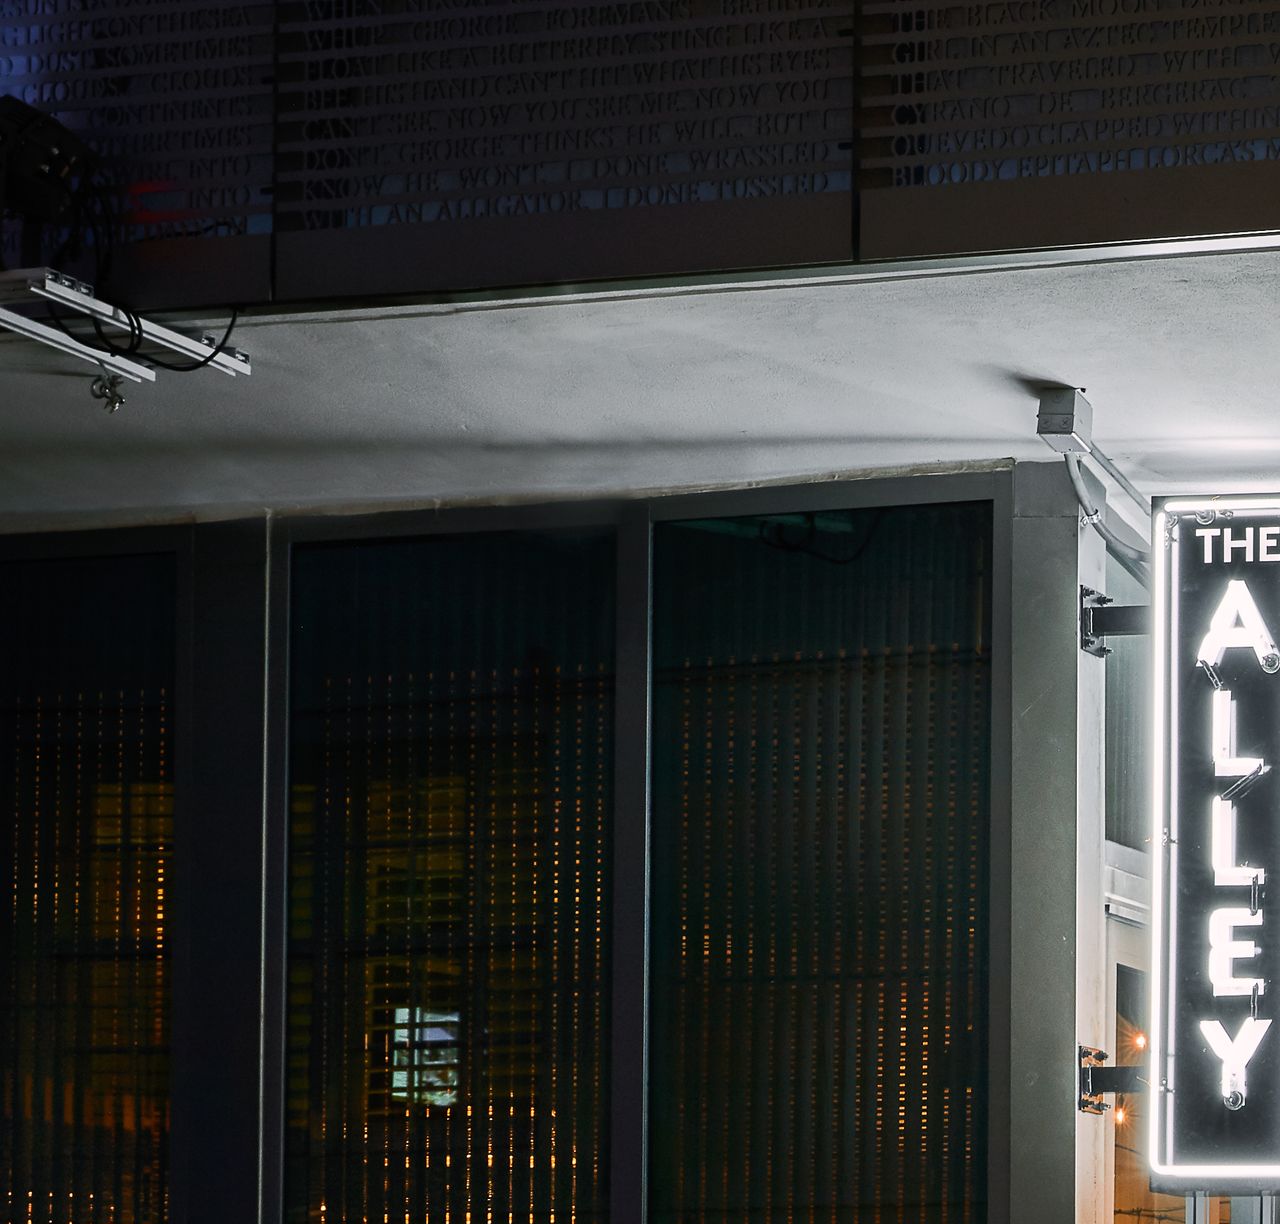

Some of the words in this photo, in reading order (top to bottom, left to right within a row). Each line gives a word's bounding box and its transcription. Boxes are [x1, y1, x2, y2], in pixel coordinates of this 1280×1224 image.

[893, 158, 1005, 188] BLOODY
[1016, 148, 1132, 178] EPITAPH
[1195, 526, 1280, 563] THE
